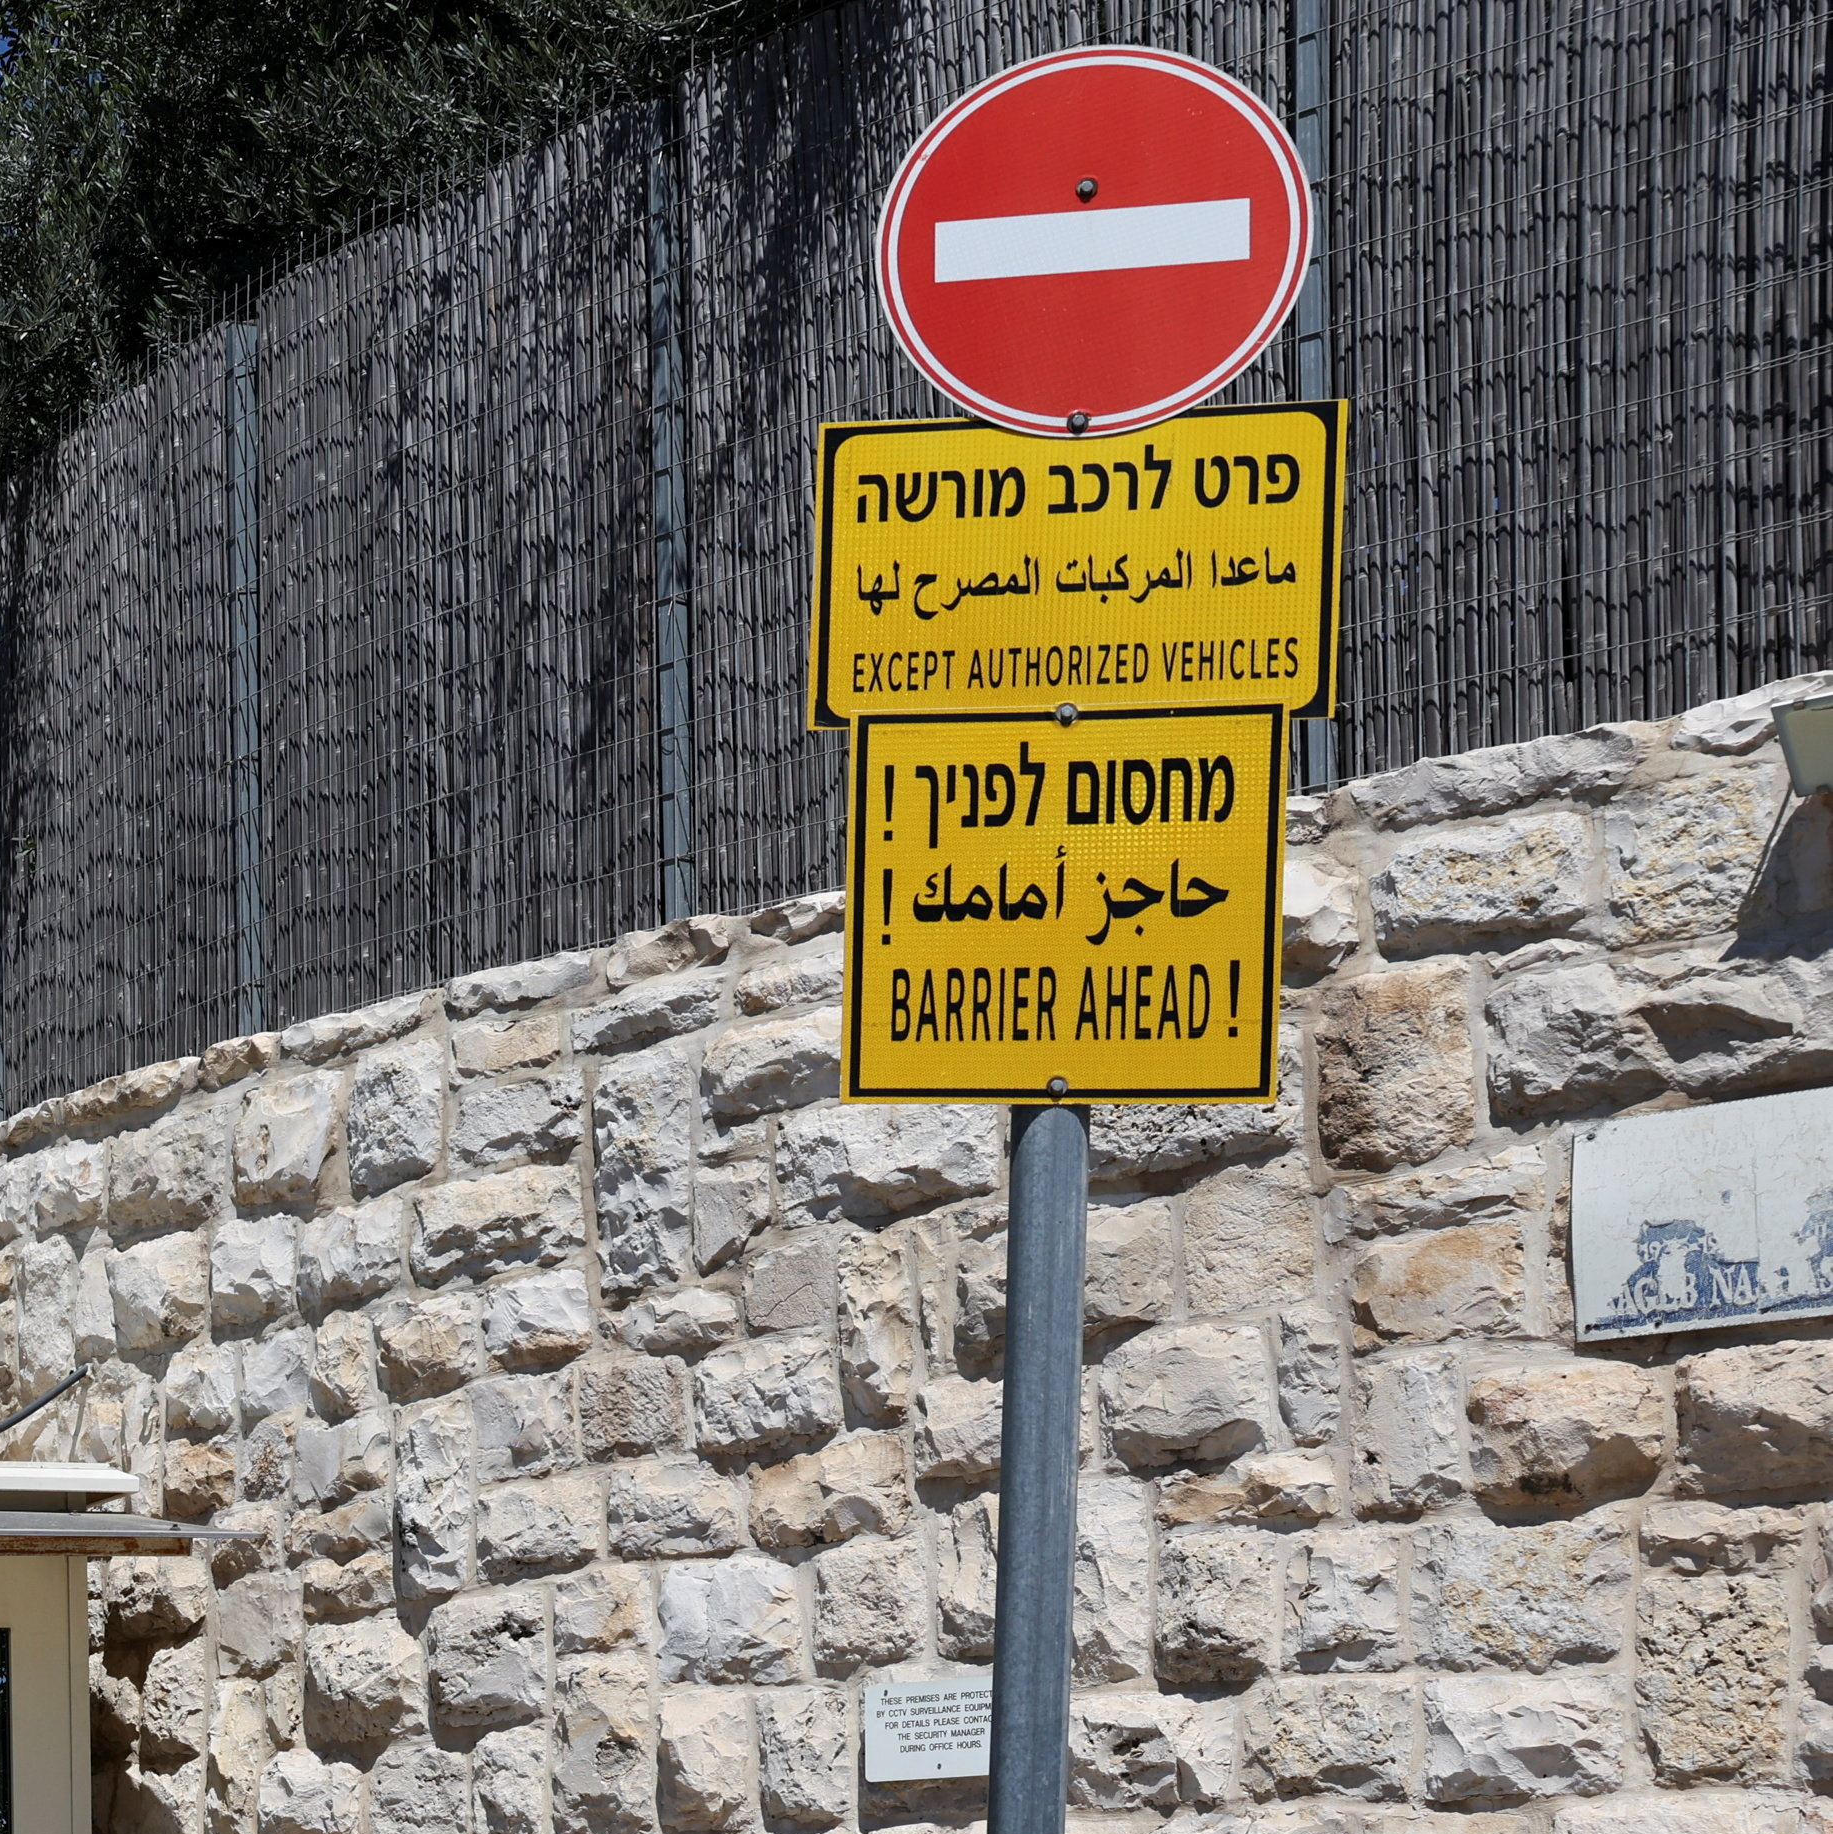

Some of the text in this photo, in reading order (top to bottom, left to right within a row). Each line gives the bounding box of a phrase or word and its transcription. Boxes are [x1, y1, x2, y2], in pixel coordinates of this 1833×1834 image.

[857, 444, 1300, 524] פרט לרכב מורשה
[857, 561, 900, 616] لها
[914, 554, 1040, 620] المصرح
[1056, 547, 1193, 603] المركبات
[852, 637, 1300, 693] EXCEPT AUTHORIZED VEHICLES
[1067, 754, 1235, 827] מחסום
[1085, 858, 1230, 946] حاجز
[891, 966, 1056, 1042] BARRIER
[876, 1703, 992, 1718] BY CCTV SURVEILLANCE EQUIPM
[880, 1690, 993, 1706] THESE PREMISES ARE PROTECT
[885, 1714, 993, 1730] FOR DETAILS PLEASE CONTAC
[897, 1728, 985, 1741] THE SECURITY MANAGER
[900, 1740, 982, 1753] DURING OFFICE HOURS.
